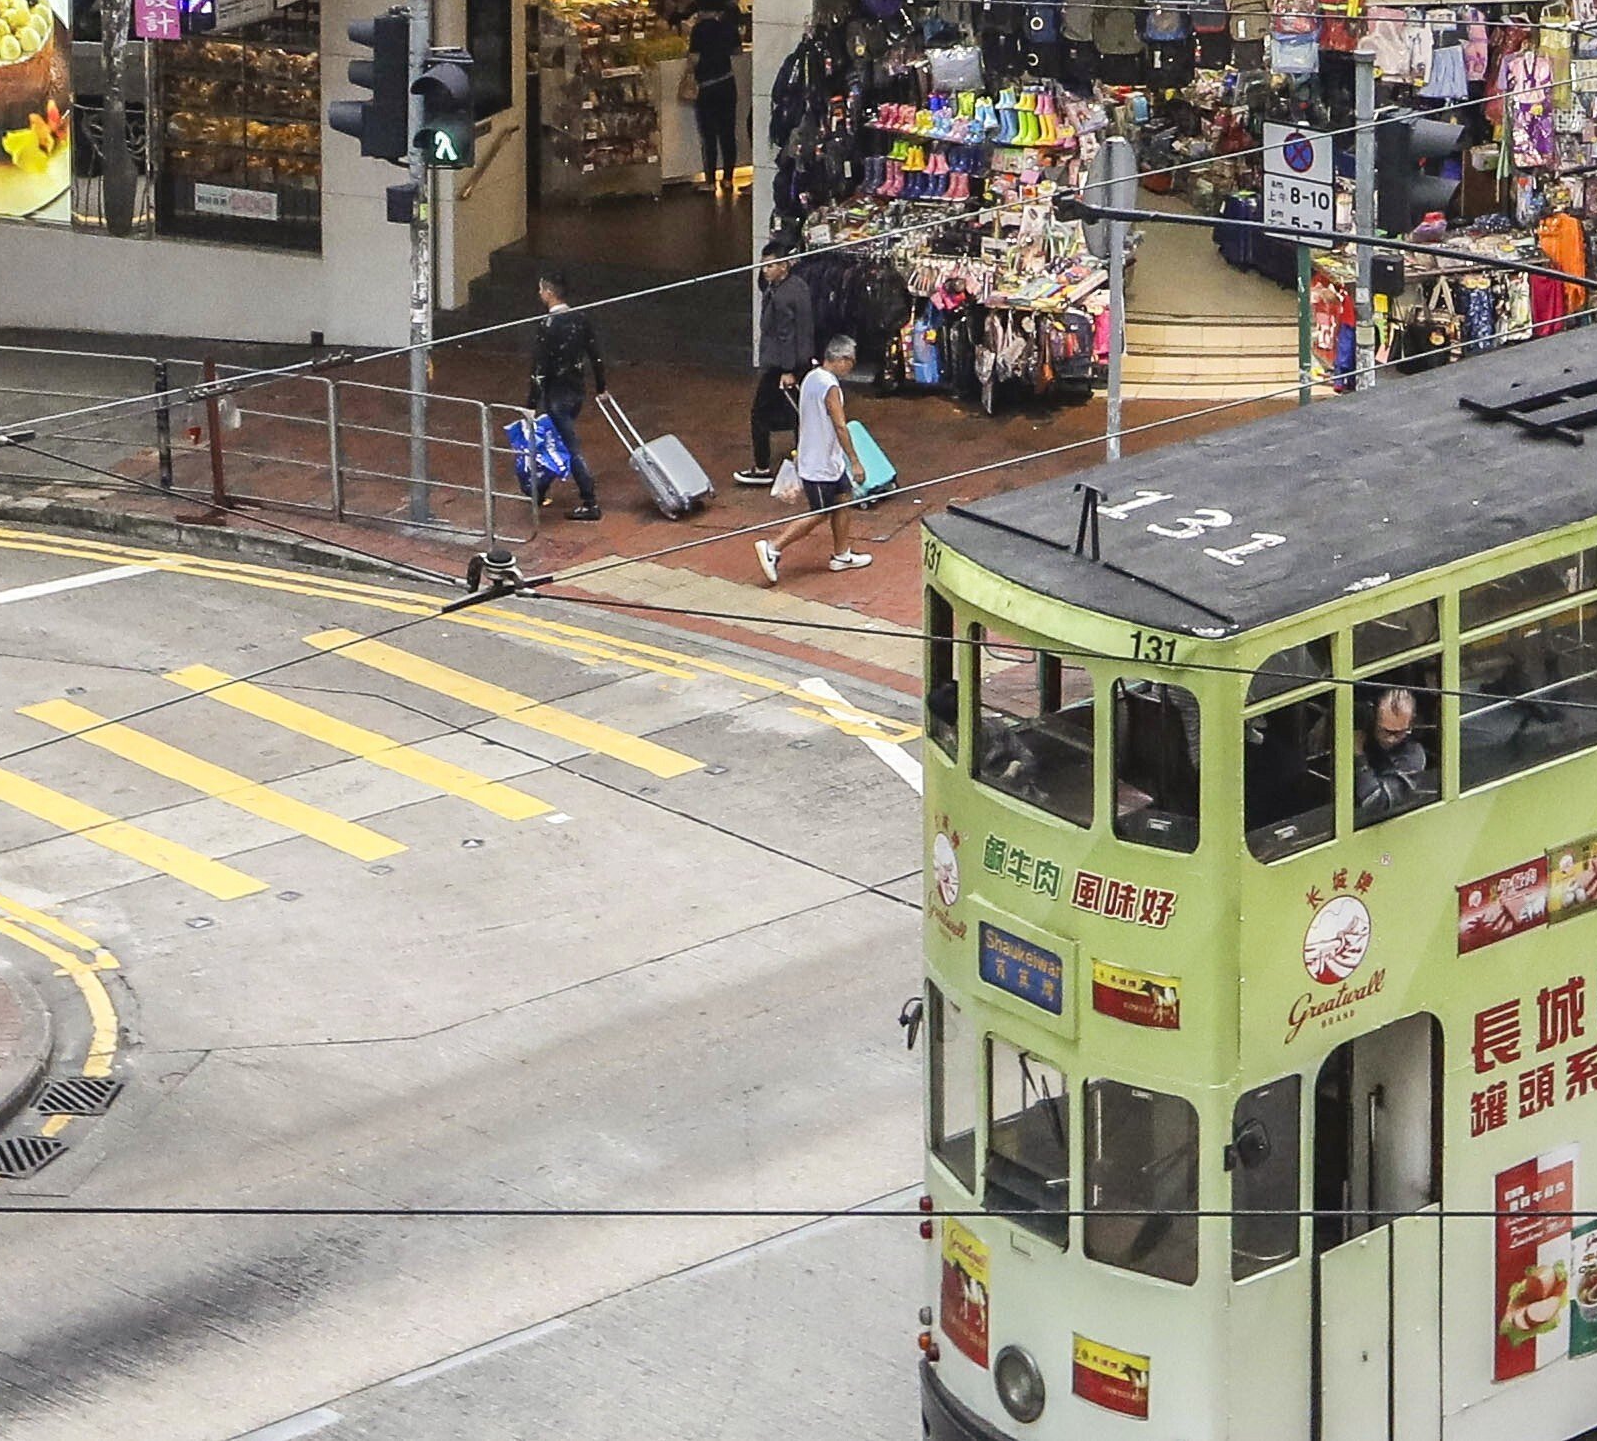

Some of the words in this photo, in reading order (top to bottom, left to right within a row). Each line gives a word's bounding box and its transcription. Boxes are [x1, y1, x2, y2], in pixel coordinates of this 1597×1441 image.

[1290, 186, 1330, 211] 8-10
[923, 538, 943, 576] 131
[1130, 630, 1178, 664] 131
[1070, 868, 1179, 930] 風味好
[1285, 968, 1386, 1045] Greatwall
[1321, 1010, 1355, 1030] BRAND
